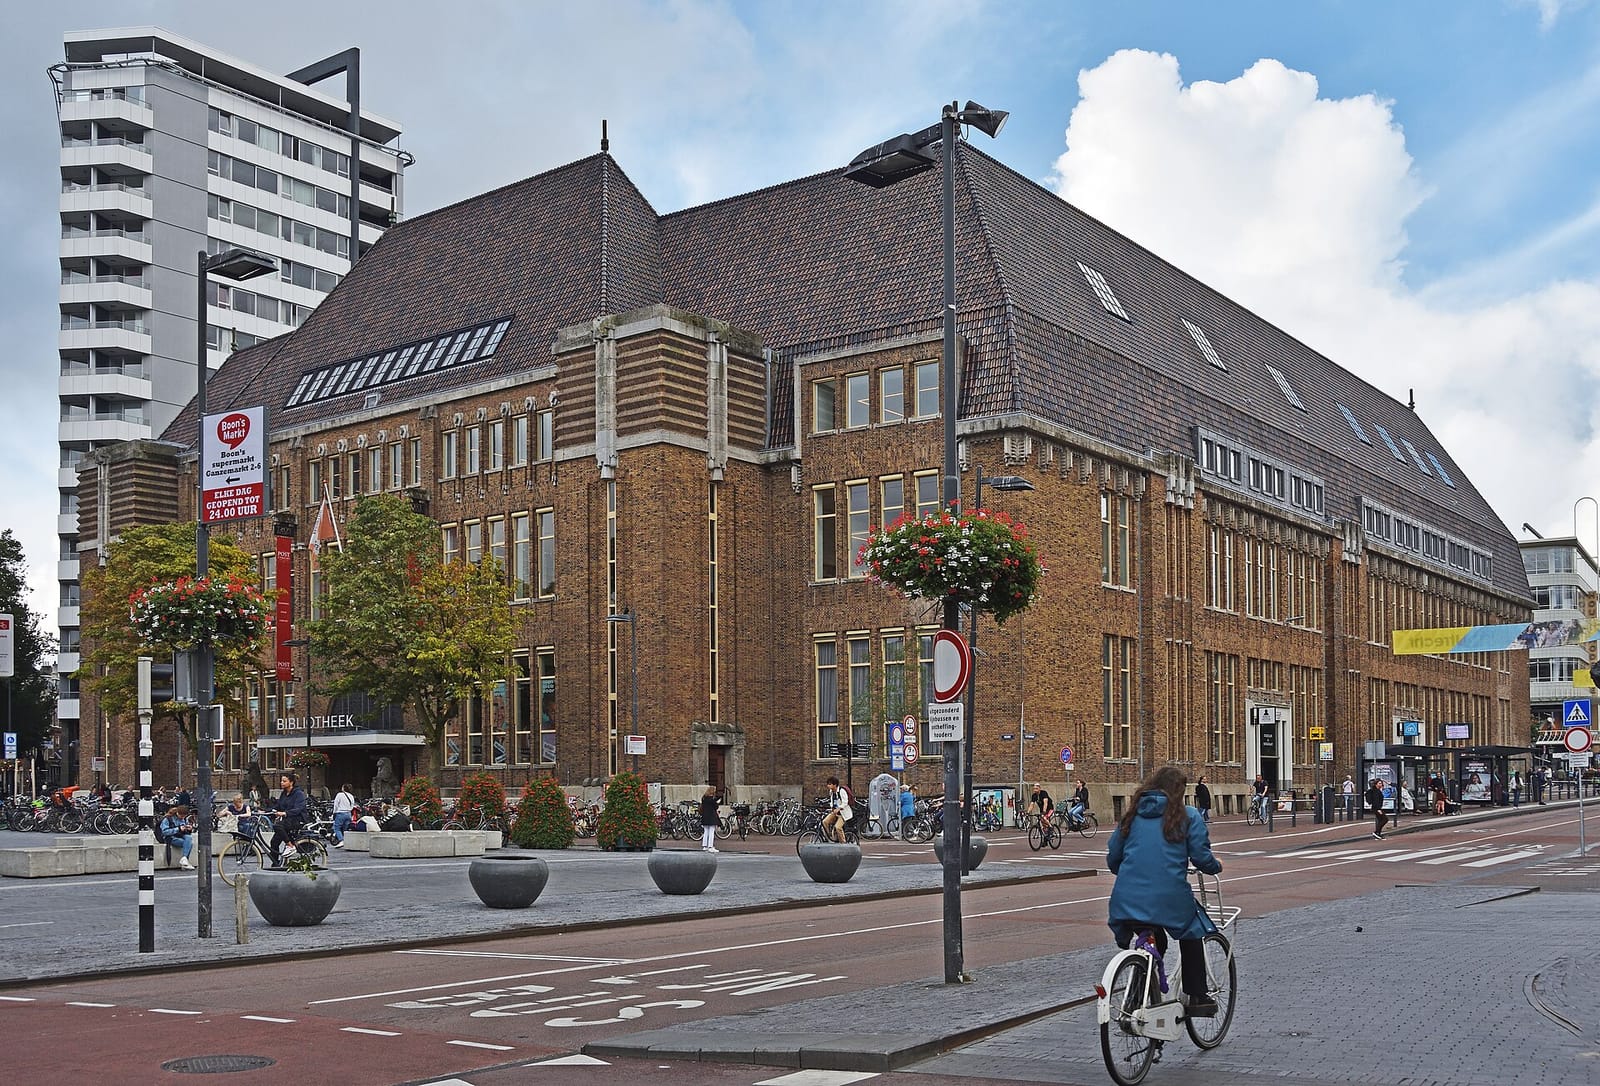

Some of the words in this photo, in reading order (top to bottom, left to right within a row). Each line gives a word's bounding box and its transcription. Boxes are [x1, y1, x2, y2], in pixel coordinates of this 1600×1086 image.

[222, 418, 246, 430] Boon's
[224, 429, 246, 440] Markt
[220, 449, 246, 458] Boon's
[212, 456, 254, 468] supermarkt
[250, 463, 261, 471] 2-6
[214, 489, 234, 498] ELKE
[236, 487, 252, 496] DAG
[206, 498, 244, 509] GEOPEND
[245, 496, 260, 504] TOT
[209, 508, 235, 519] 24.00
[238, 505, 257, 515] UUR
[276, 714, 354, 731] BIBLIOTHEEK
[384, 984, 706, 1028] BUS
